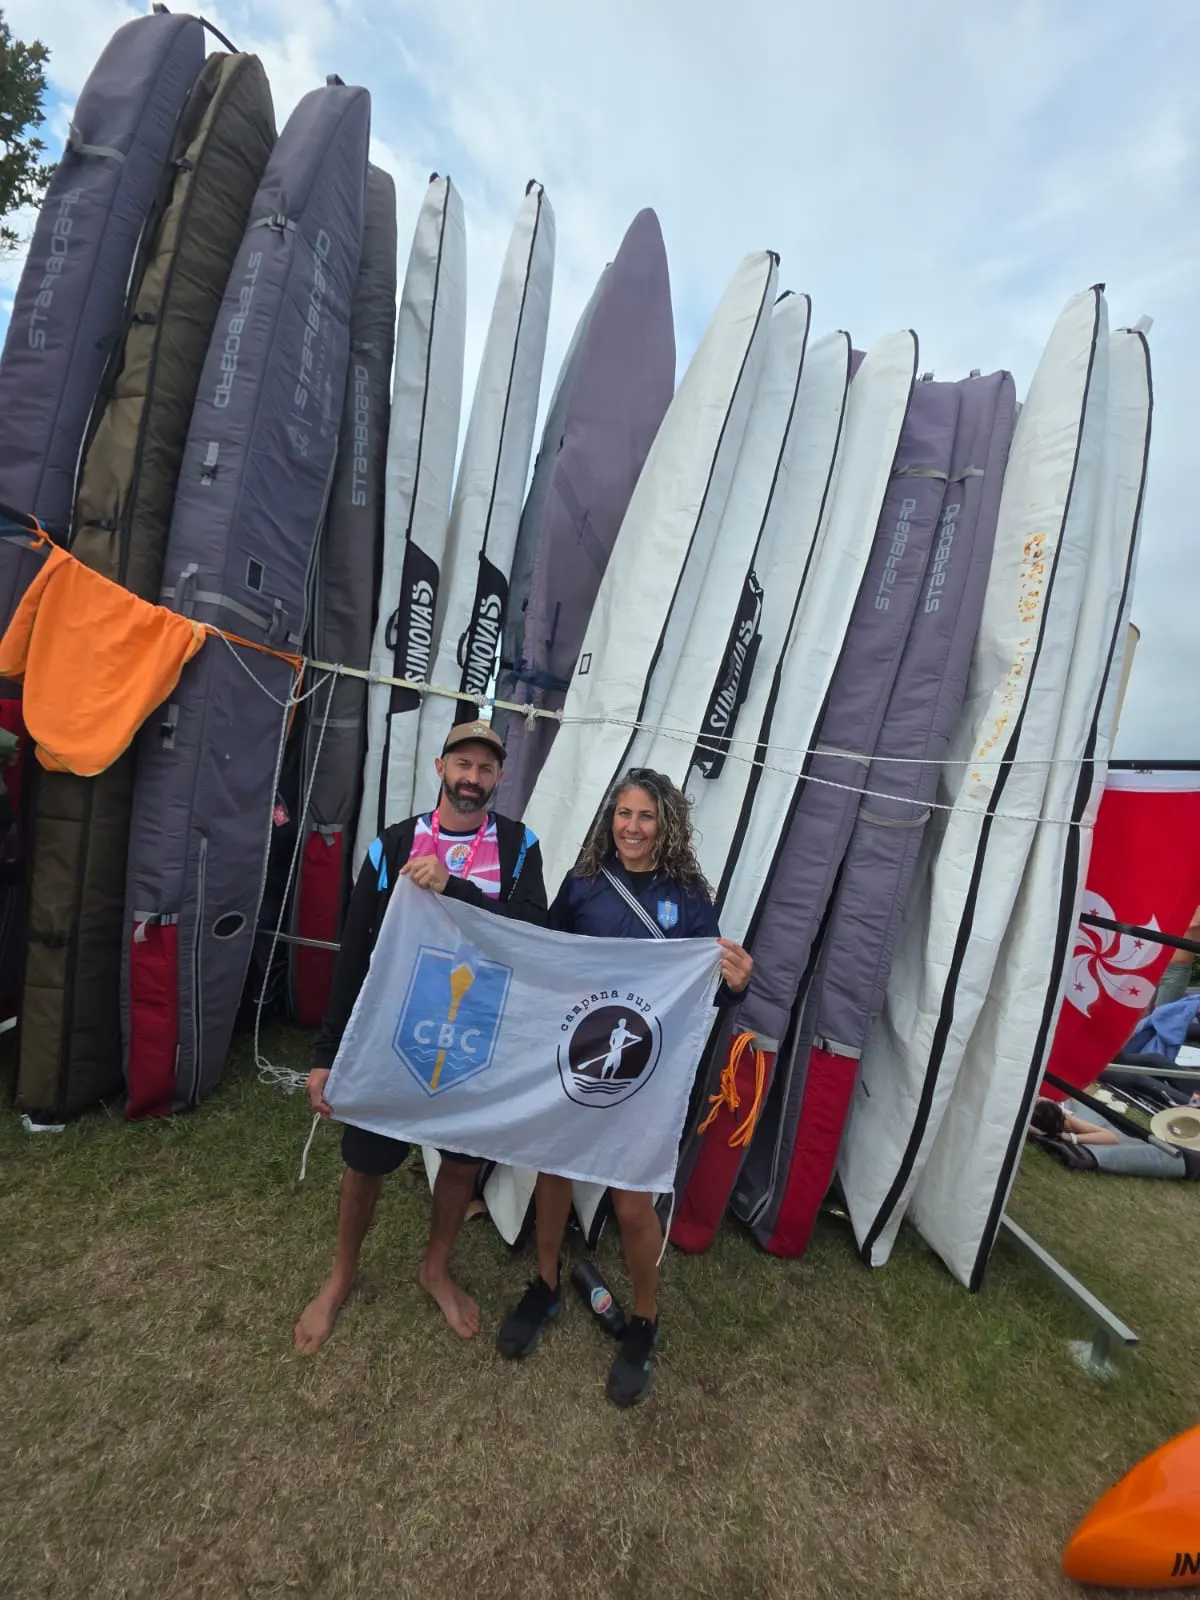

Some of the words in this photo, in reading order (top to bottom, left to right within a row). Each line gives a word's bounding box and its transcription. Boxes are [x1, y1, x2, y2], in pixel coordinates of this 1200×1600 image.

[404, 603, 433, 685] SUNOVA
[465, 617, 500, 696] SUNOVA
[413, 1019, 481, 1054] CBC
[560, 989, 619, 1032] campana
[626, 992, 652, 1013] sup
